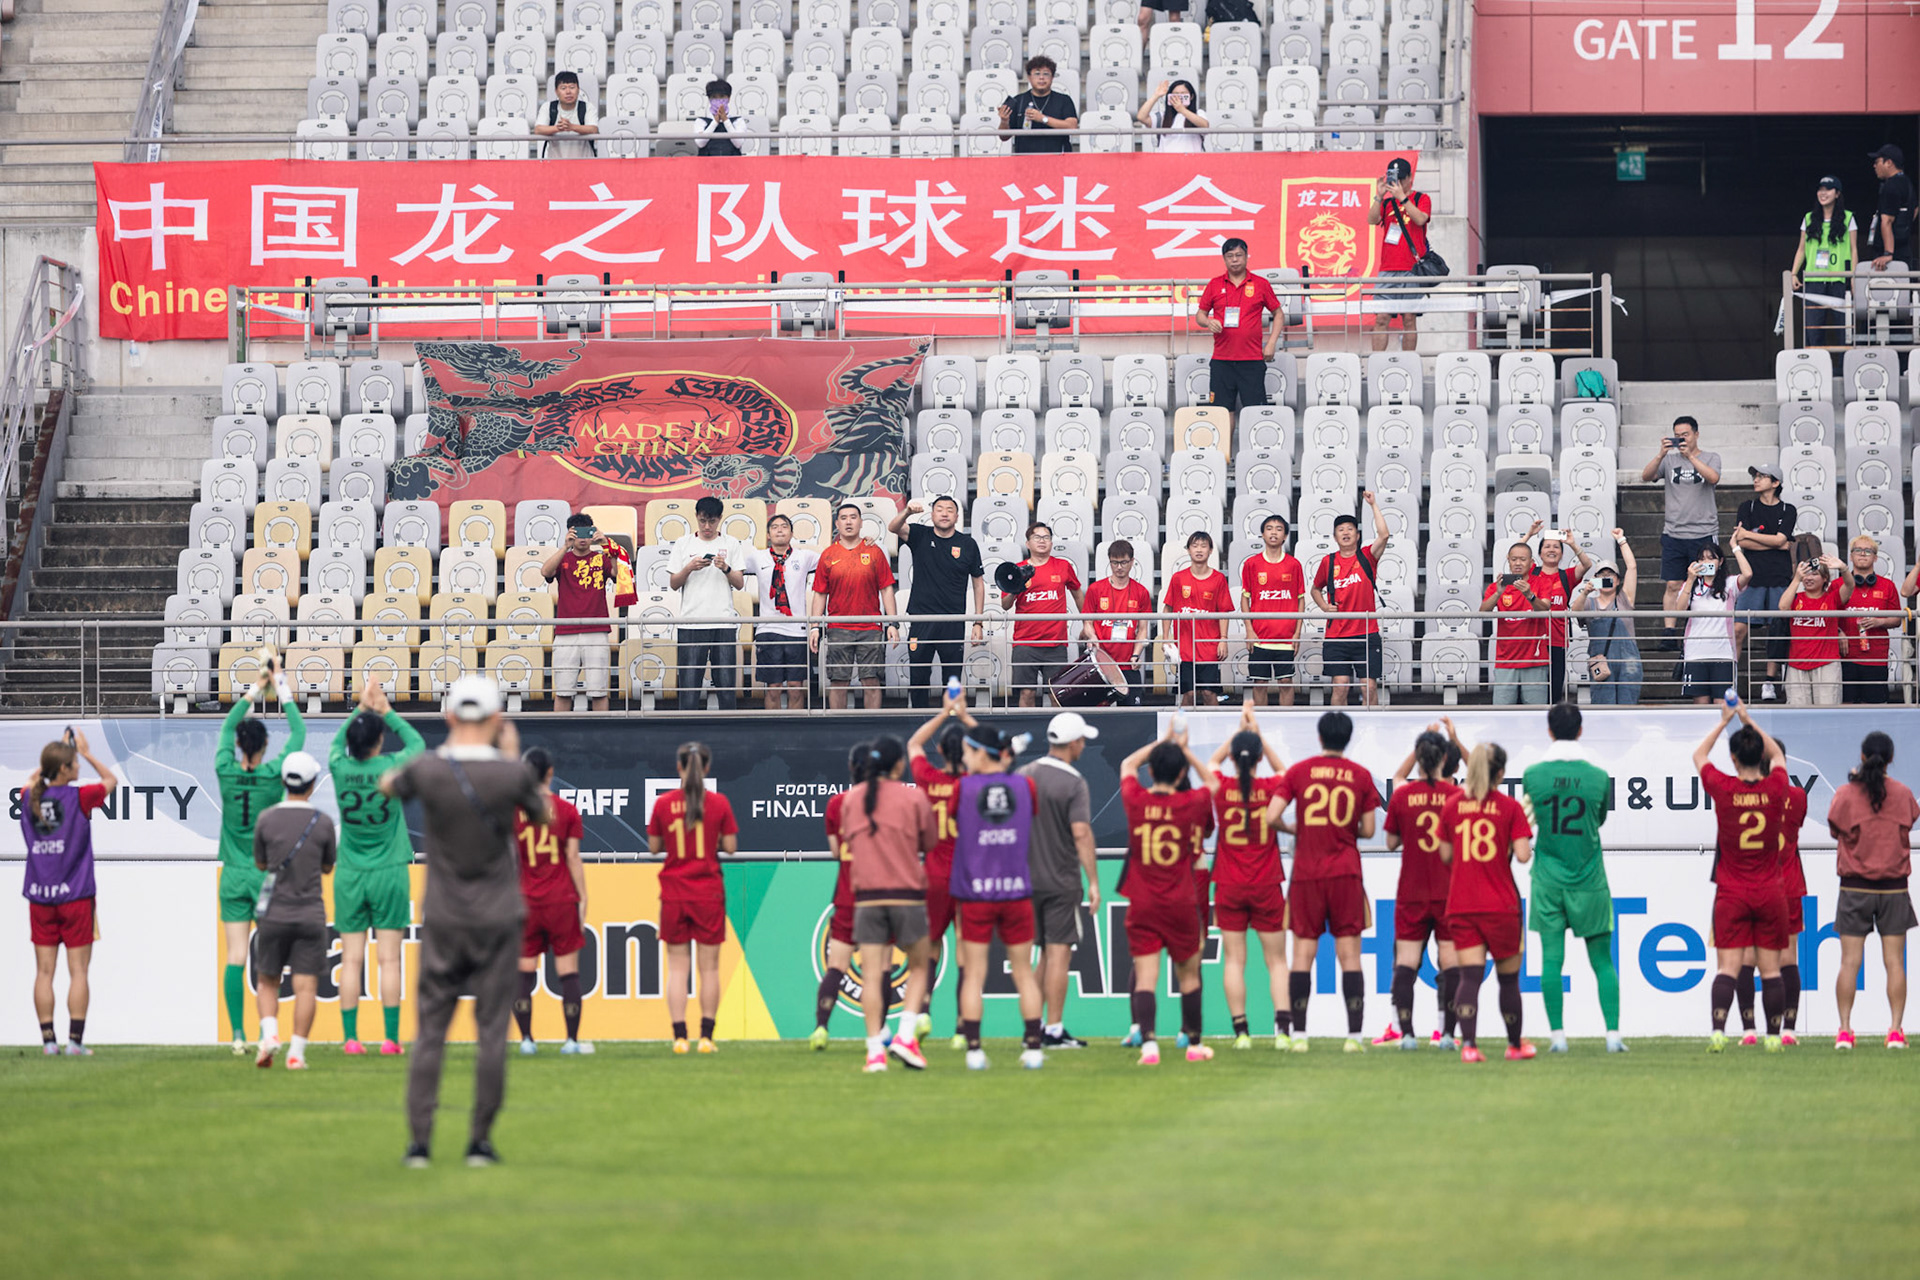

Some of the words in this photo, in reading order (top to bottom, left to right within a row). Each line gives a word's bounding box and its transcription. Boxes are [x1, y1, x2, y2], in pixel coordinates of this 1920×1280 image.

[1573, 19, 1697, 60] GATE
[1717, 0, 1845, 60] 12
[1297, 189, 1361, 208] 龙之队
[108, 174, 1265, 271] 中国龙之队球迷会
[577, 421, 688, 440] MADE
[690, 421, 731, 440] IN
[593, 441, 713, 456] CHINA
[90, 786, 198, 820] NITY
[234, 790, 250, 827] 1
[340, 790, 390, 825] 23
[752, 800, 824, 818] FINAL
[1304, 783, 1355, 827] 20
[1627, 776, 1653, 811] &
[1223, 806, 1268, 845] 21
[1416, 811, 1440, 852] 3
[1543, 795, 1586, 835] 12
[1739, 811, 1766, 850] 2
[518, 826, 559, 867] 14
[668, 818, 705, 859] 11
[1133, 823, 1182, 866] 16
[1455, 818, 1497, 862] 18
